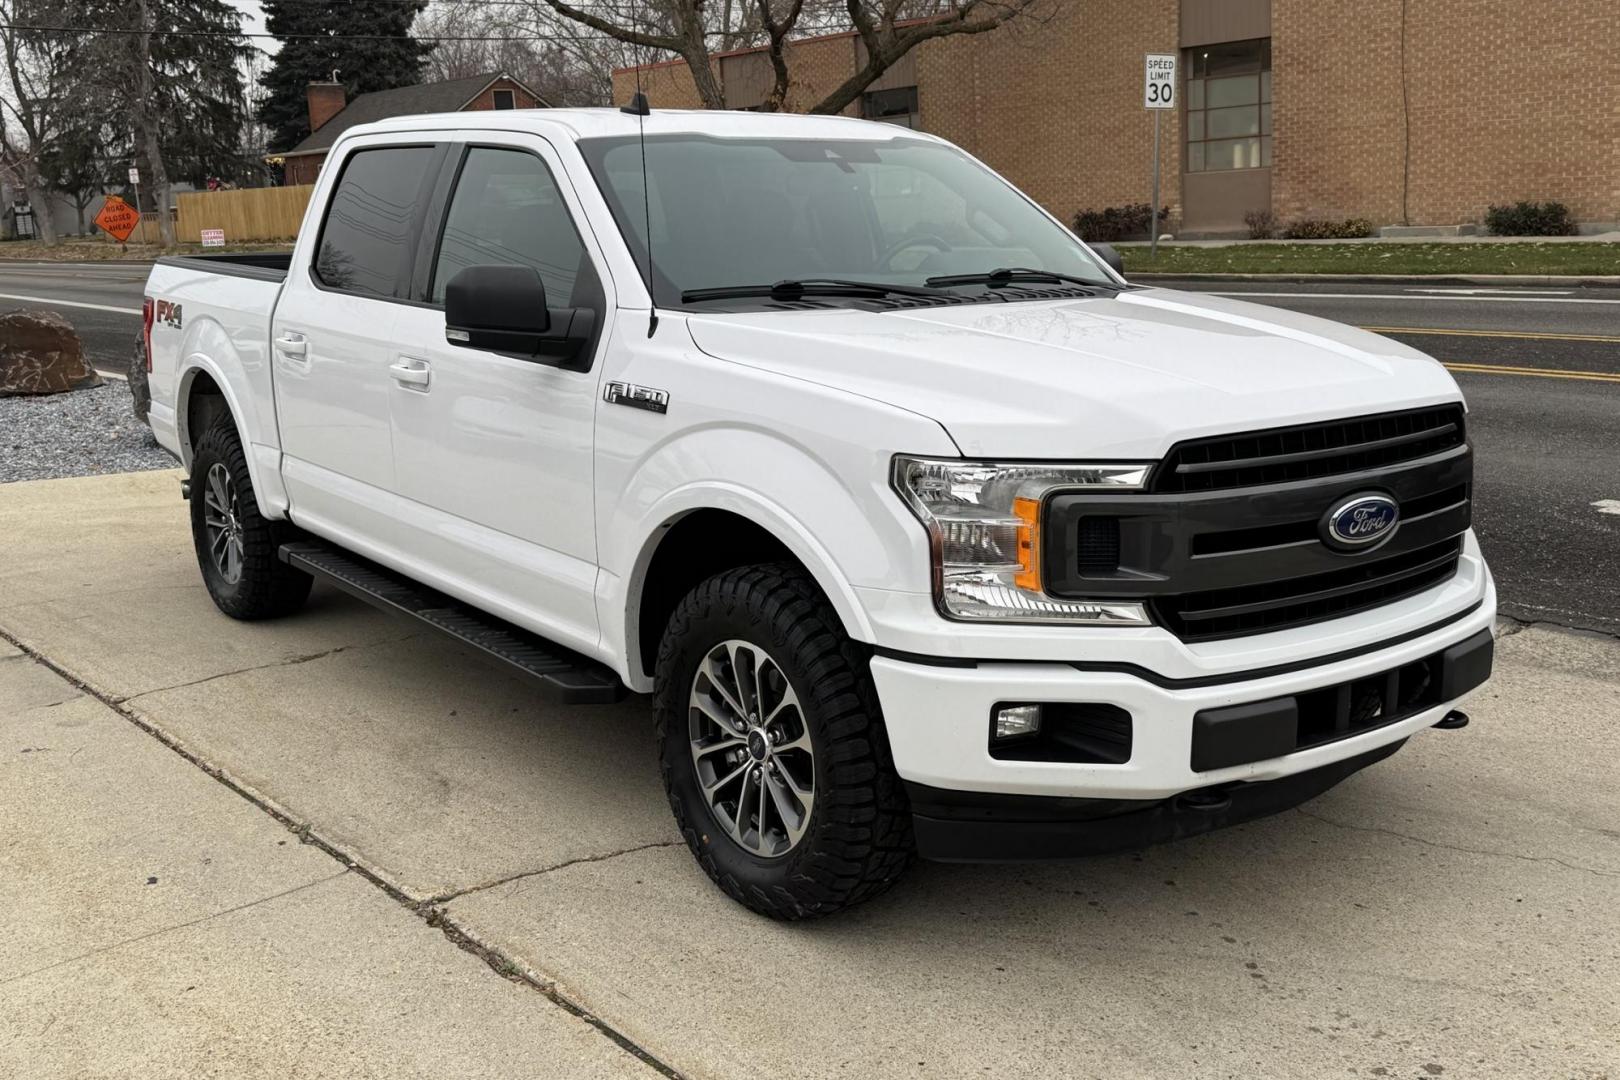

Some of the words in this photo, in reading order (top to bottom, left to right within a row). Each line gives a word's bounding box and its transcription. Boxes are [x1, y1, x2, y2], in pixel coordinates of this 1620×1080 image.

[1148, 60, 1174, 69] SPEED
[1150, 71, 1171, 80] LIMIT
[1148, 83, 1172, 102] 30
[105, 204, 125, 212] ROAD
[104, 213, 131, 223] CLOSED
[108, 223, 132, 231] AHEAD
[157, 299, 182, 325] FX4
[1349, 506, 1387, 535] Ford
